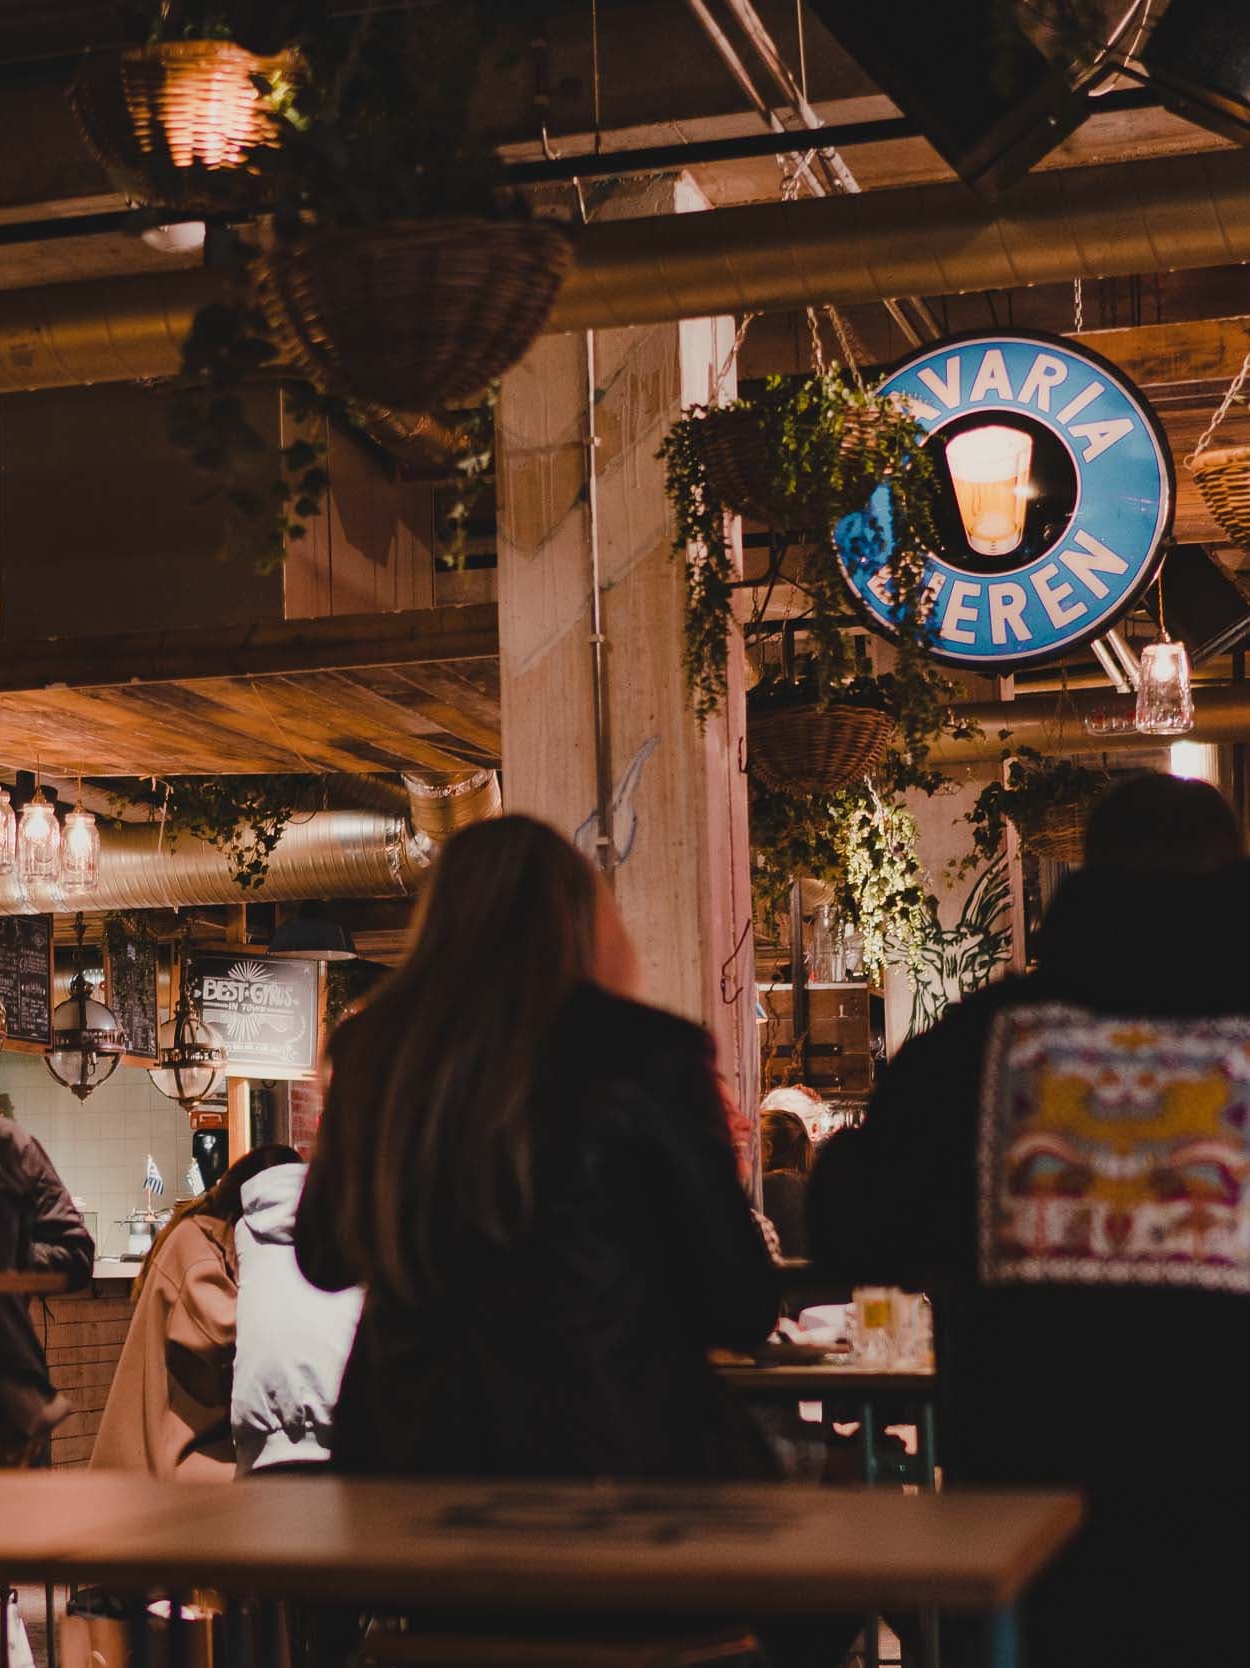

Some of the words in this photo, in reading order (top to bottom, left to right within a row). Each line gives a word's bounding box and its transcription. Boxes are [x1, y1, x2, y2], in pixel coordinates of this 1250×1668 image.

[882, 349, 1135, 464] AVARIA
[203, 979, 249, 1002] BEST
[228, 1002, 239, 1011] IN
